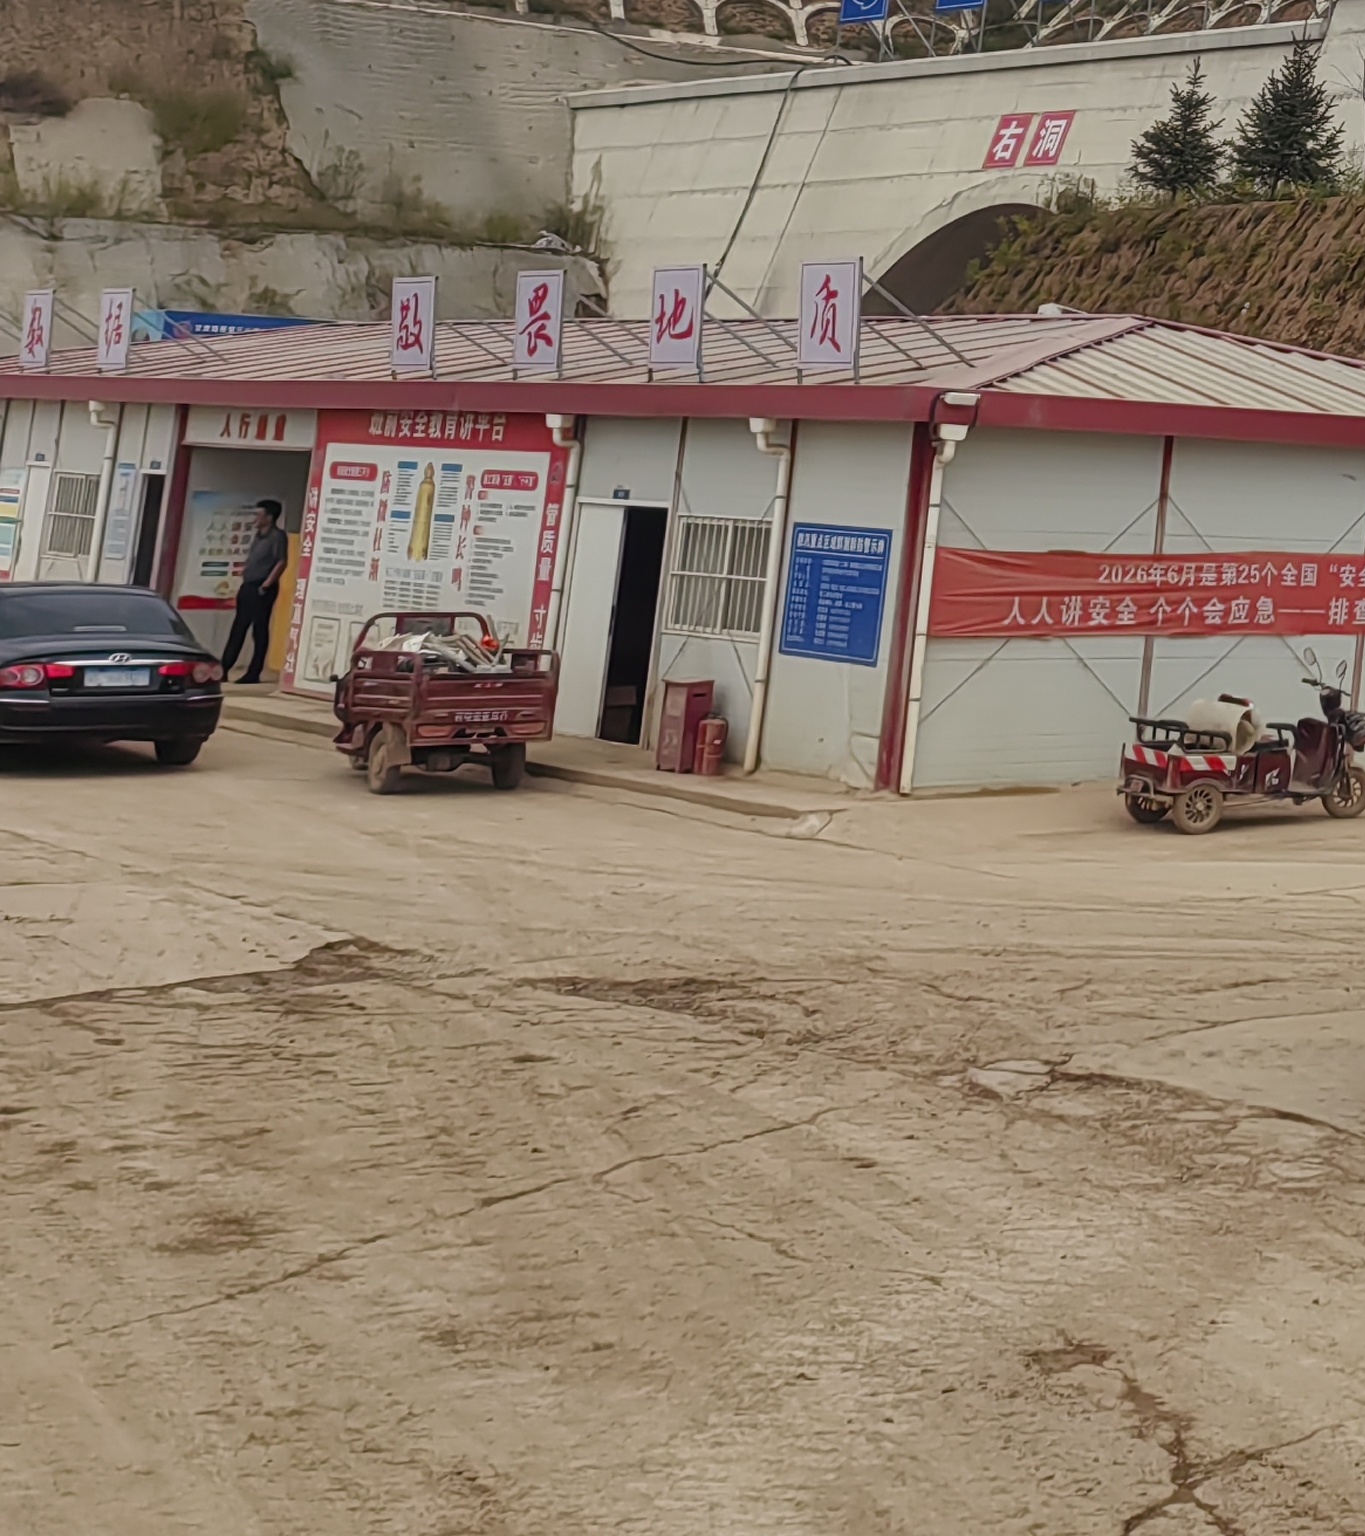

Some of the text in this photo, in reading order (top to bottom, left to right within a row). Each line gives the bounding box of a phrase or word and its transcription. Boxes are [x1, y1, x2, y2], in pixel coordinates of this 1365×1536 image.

[991, 117, 1068, 162] 右洞
[1003, 595, 1138, 626] 人人讲安全
